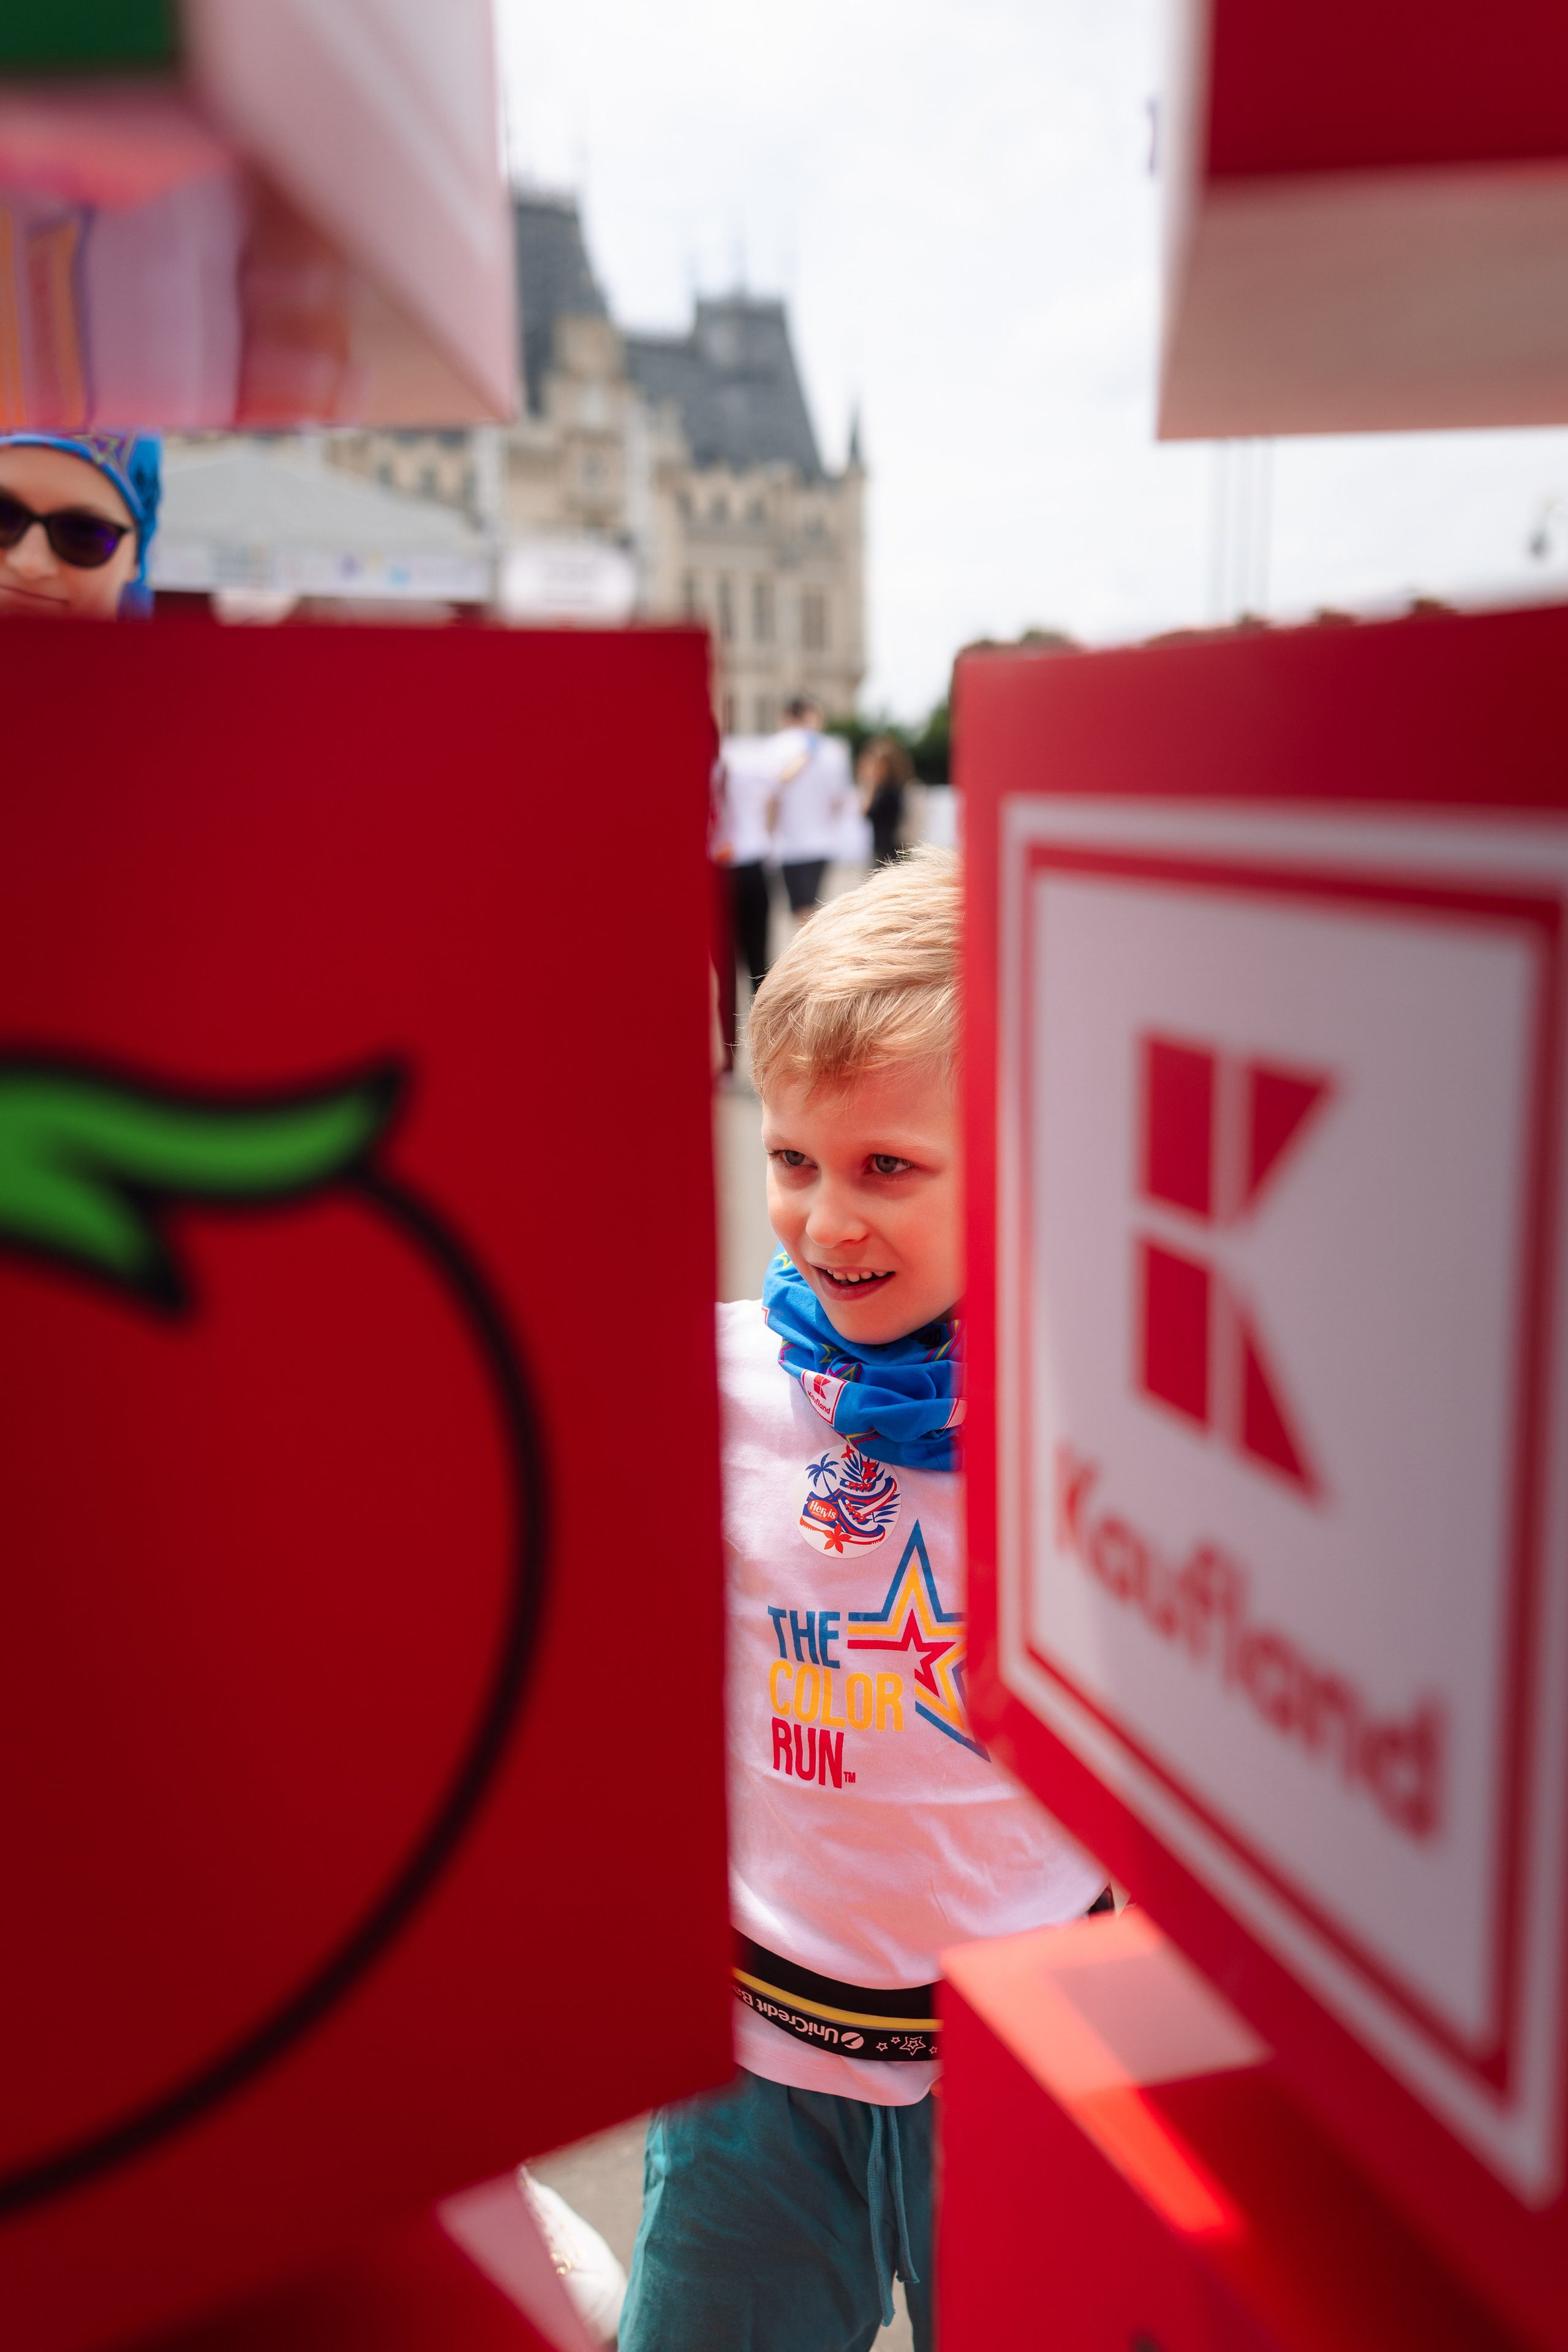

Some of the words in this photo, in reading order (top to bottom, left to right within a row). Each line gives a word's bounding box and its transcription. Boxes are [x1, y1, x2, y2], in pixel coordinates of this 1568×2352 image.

[810, 1501, 837, 1519] Hervis
[767, 1605, 840, 1669] THE
[1058, 1449, 1444, 1845] Kaufland
[769, 1660, 903, 1732] COLOR
[772, 1717, 843, 1789] RUN
[756, 1999, 839, 2043] UniCredit
